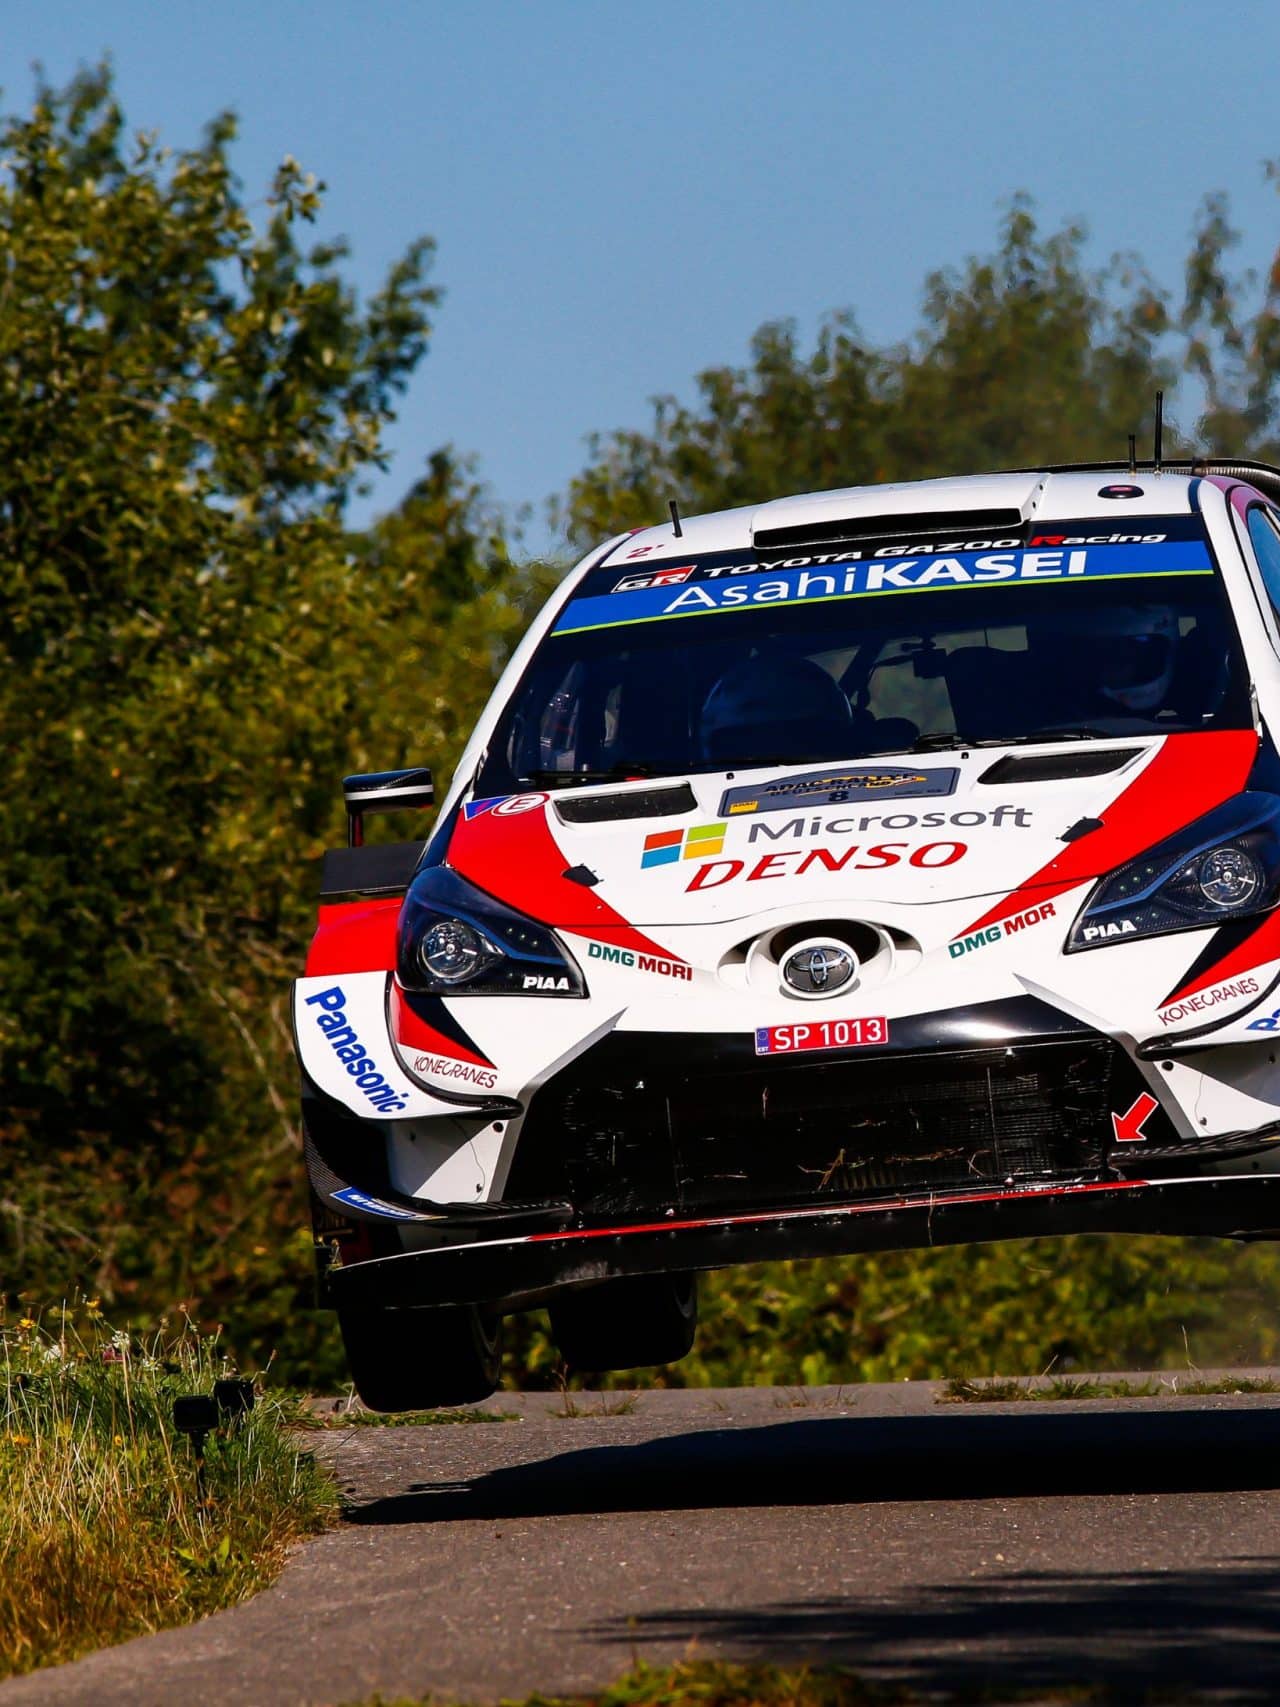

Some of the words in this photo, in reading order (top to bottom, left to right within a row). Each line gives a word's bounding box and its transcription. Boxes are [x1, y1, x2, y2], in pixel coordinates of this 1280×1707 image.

[704, 551, 862, 578] TOYOTA
[874, 539, 1021, 557] GAZOO
[1029, 533, 1167, 547] Racing
[615, 572, 685, 591] GR
[828, 791, 849, 802] 8
[748, 805, 1033, 843] Microsoft
[685, 842, 968, 893] DENSO
[948, 926, 1001, 959] DMG
[1082, 919, 1137, 942] PIAA
[587, 942, 634, 967] DMG
[638, 955, 693, 981] MORI
[522, 975, 570, 990] PIAA
[1157, 977, 1259, 1027] KONECRANES
[304, 986, 410, 1113] Panasonic
[774, 1026, 810, 1050] SP
[819, 1019, 882, 1046] 1013
[413, 1056, 498, 1089] KONECRANES
